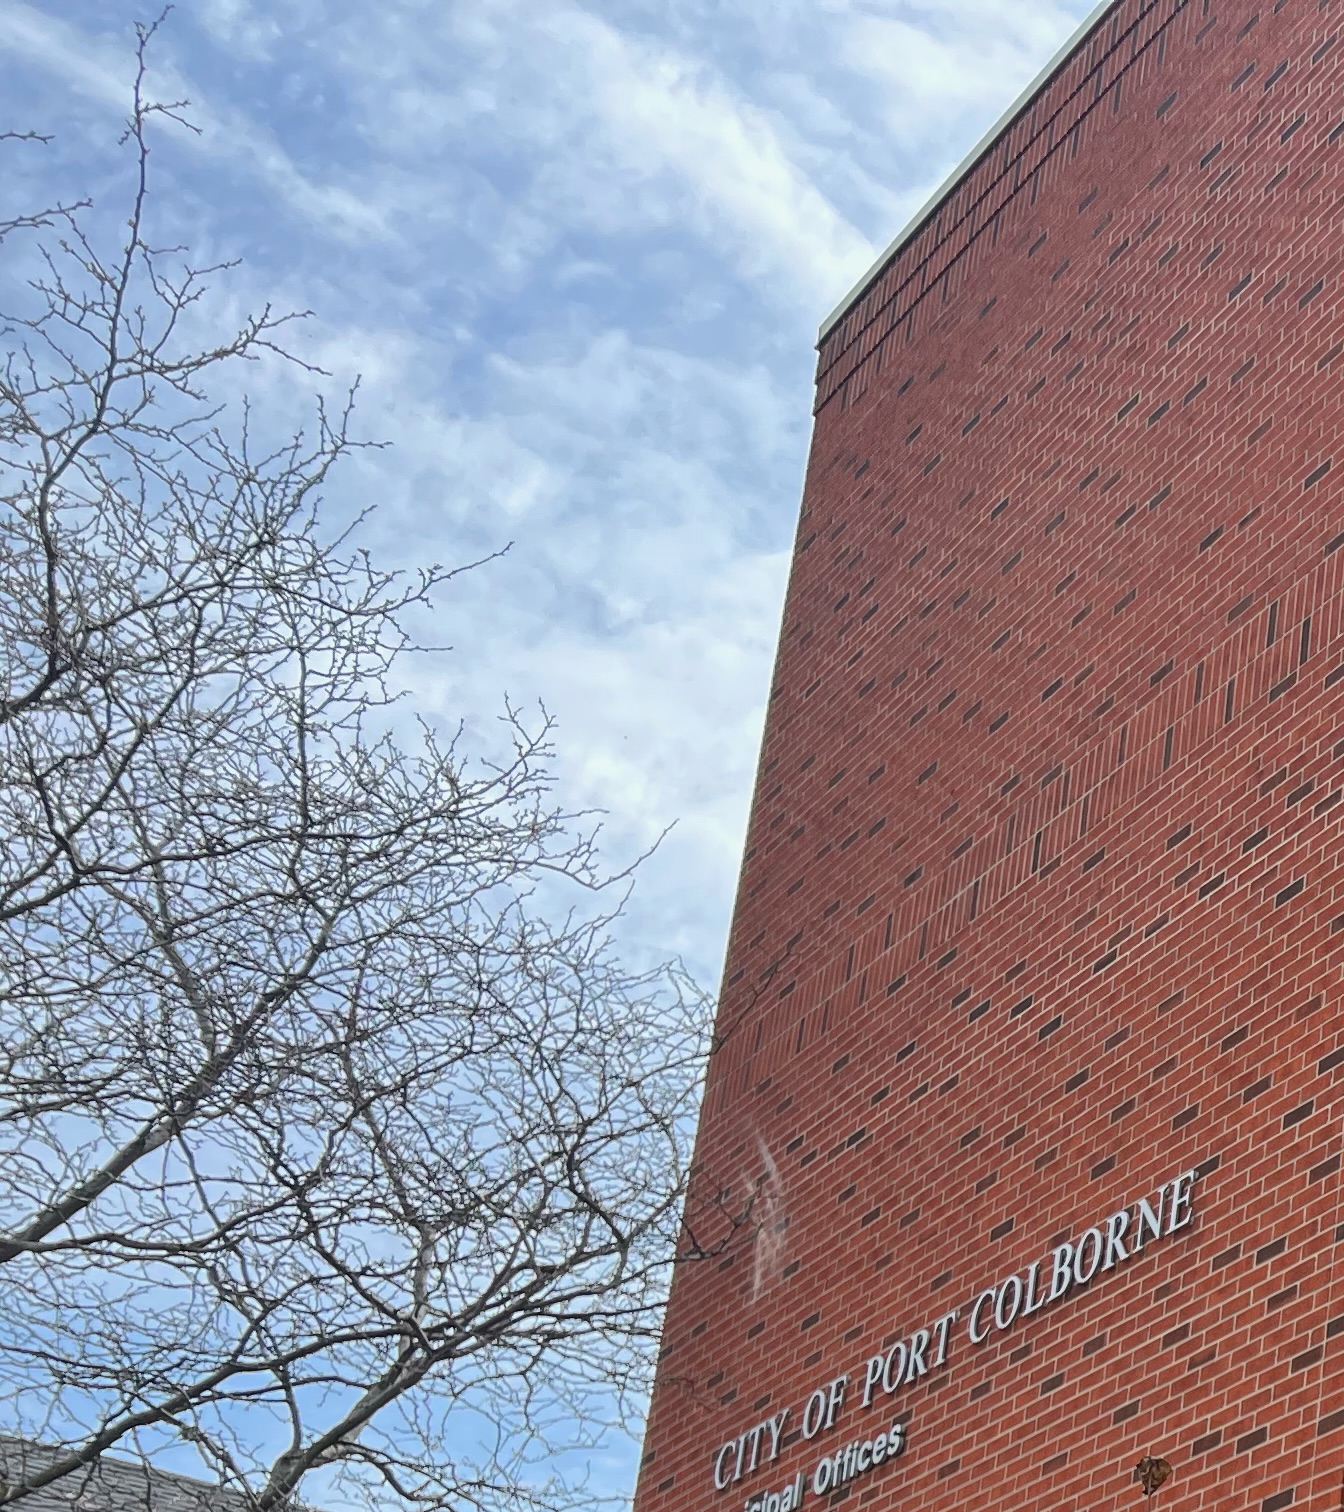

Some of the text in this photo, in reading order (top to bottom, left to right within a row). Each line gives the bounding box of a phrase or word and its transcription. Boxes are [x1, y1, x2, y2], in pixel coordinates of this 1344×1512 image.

[713, 1169, 1198, 1490] CITY OF PORT COLBORNE
[813, 1423, 903, 1496] Offices
